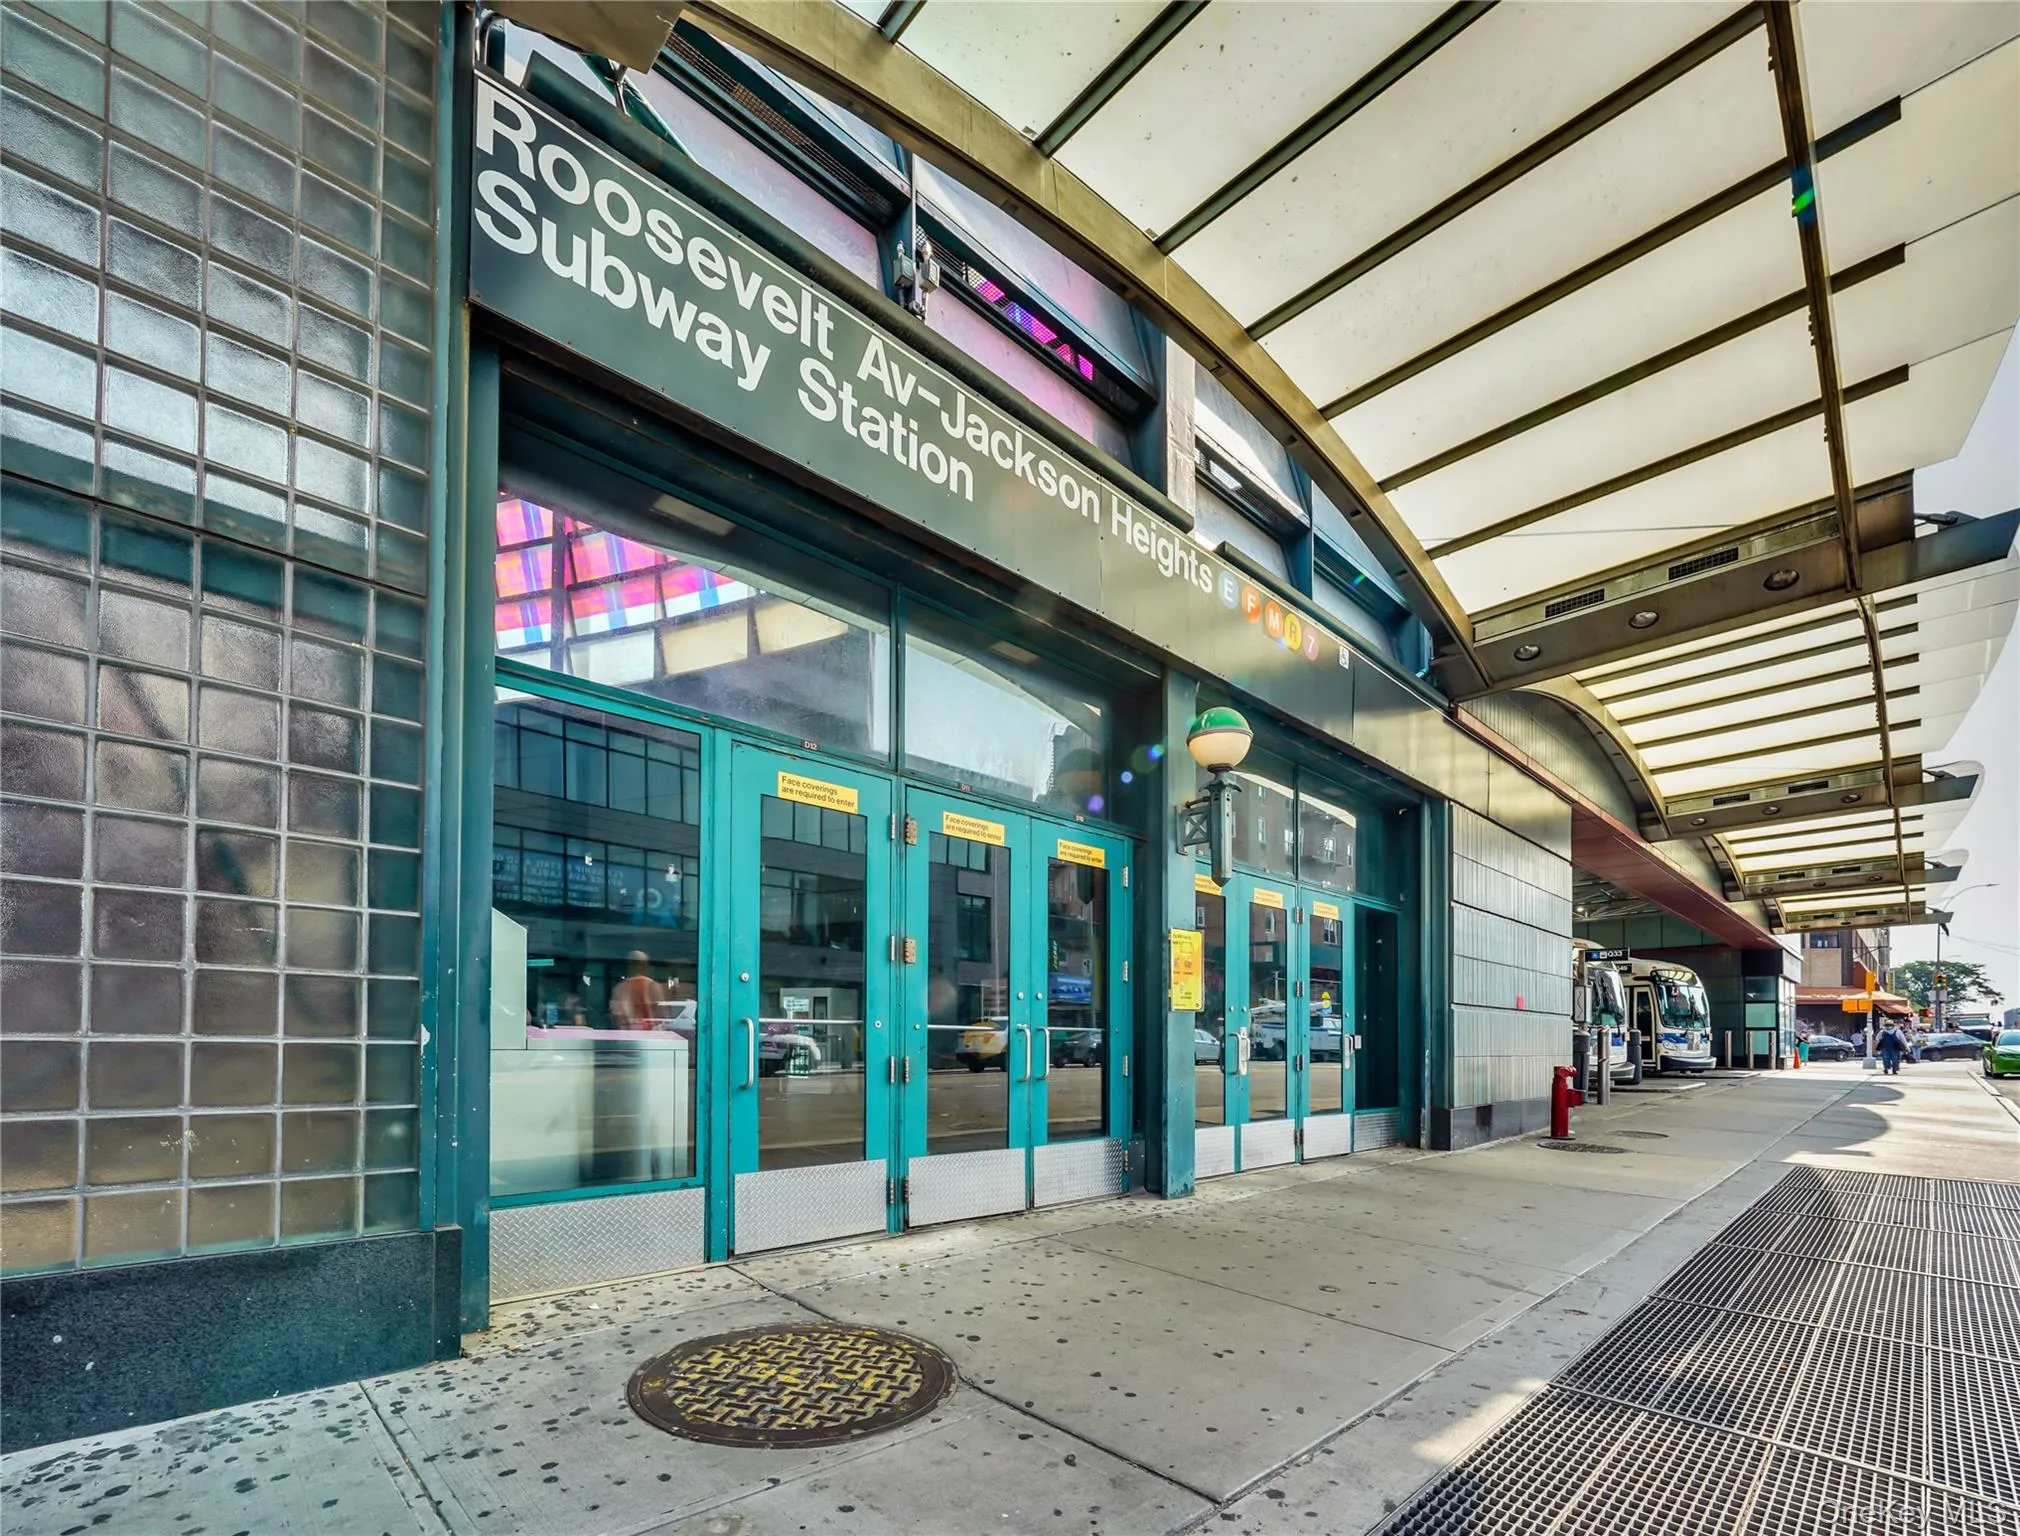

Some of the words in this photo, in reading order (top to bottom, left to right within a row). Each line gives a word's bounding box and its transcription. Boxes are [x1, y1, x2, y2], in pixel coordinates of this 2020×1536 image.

[474, 168, 771, 392] Subway
[797, 357, 974, 502] Station
[475, 78, 835, 361] Roosevelt
[1110, 494, 1213, 594] Heights
[804, 741, 818, 751] D12
[781, 775, 801, 788] Face
[801, 782, 839, 797] coverings
[781, 785, 795, 796] are
[795, 788, 827, 803] required
[827, 794, 836, 804] to
[836, 798, 855, 808] enter
[945, 814, 961, 825] Face
[960, 819, 989, 831] coverings
